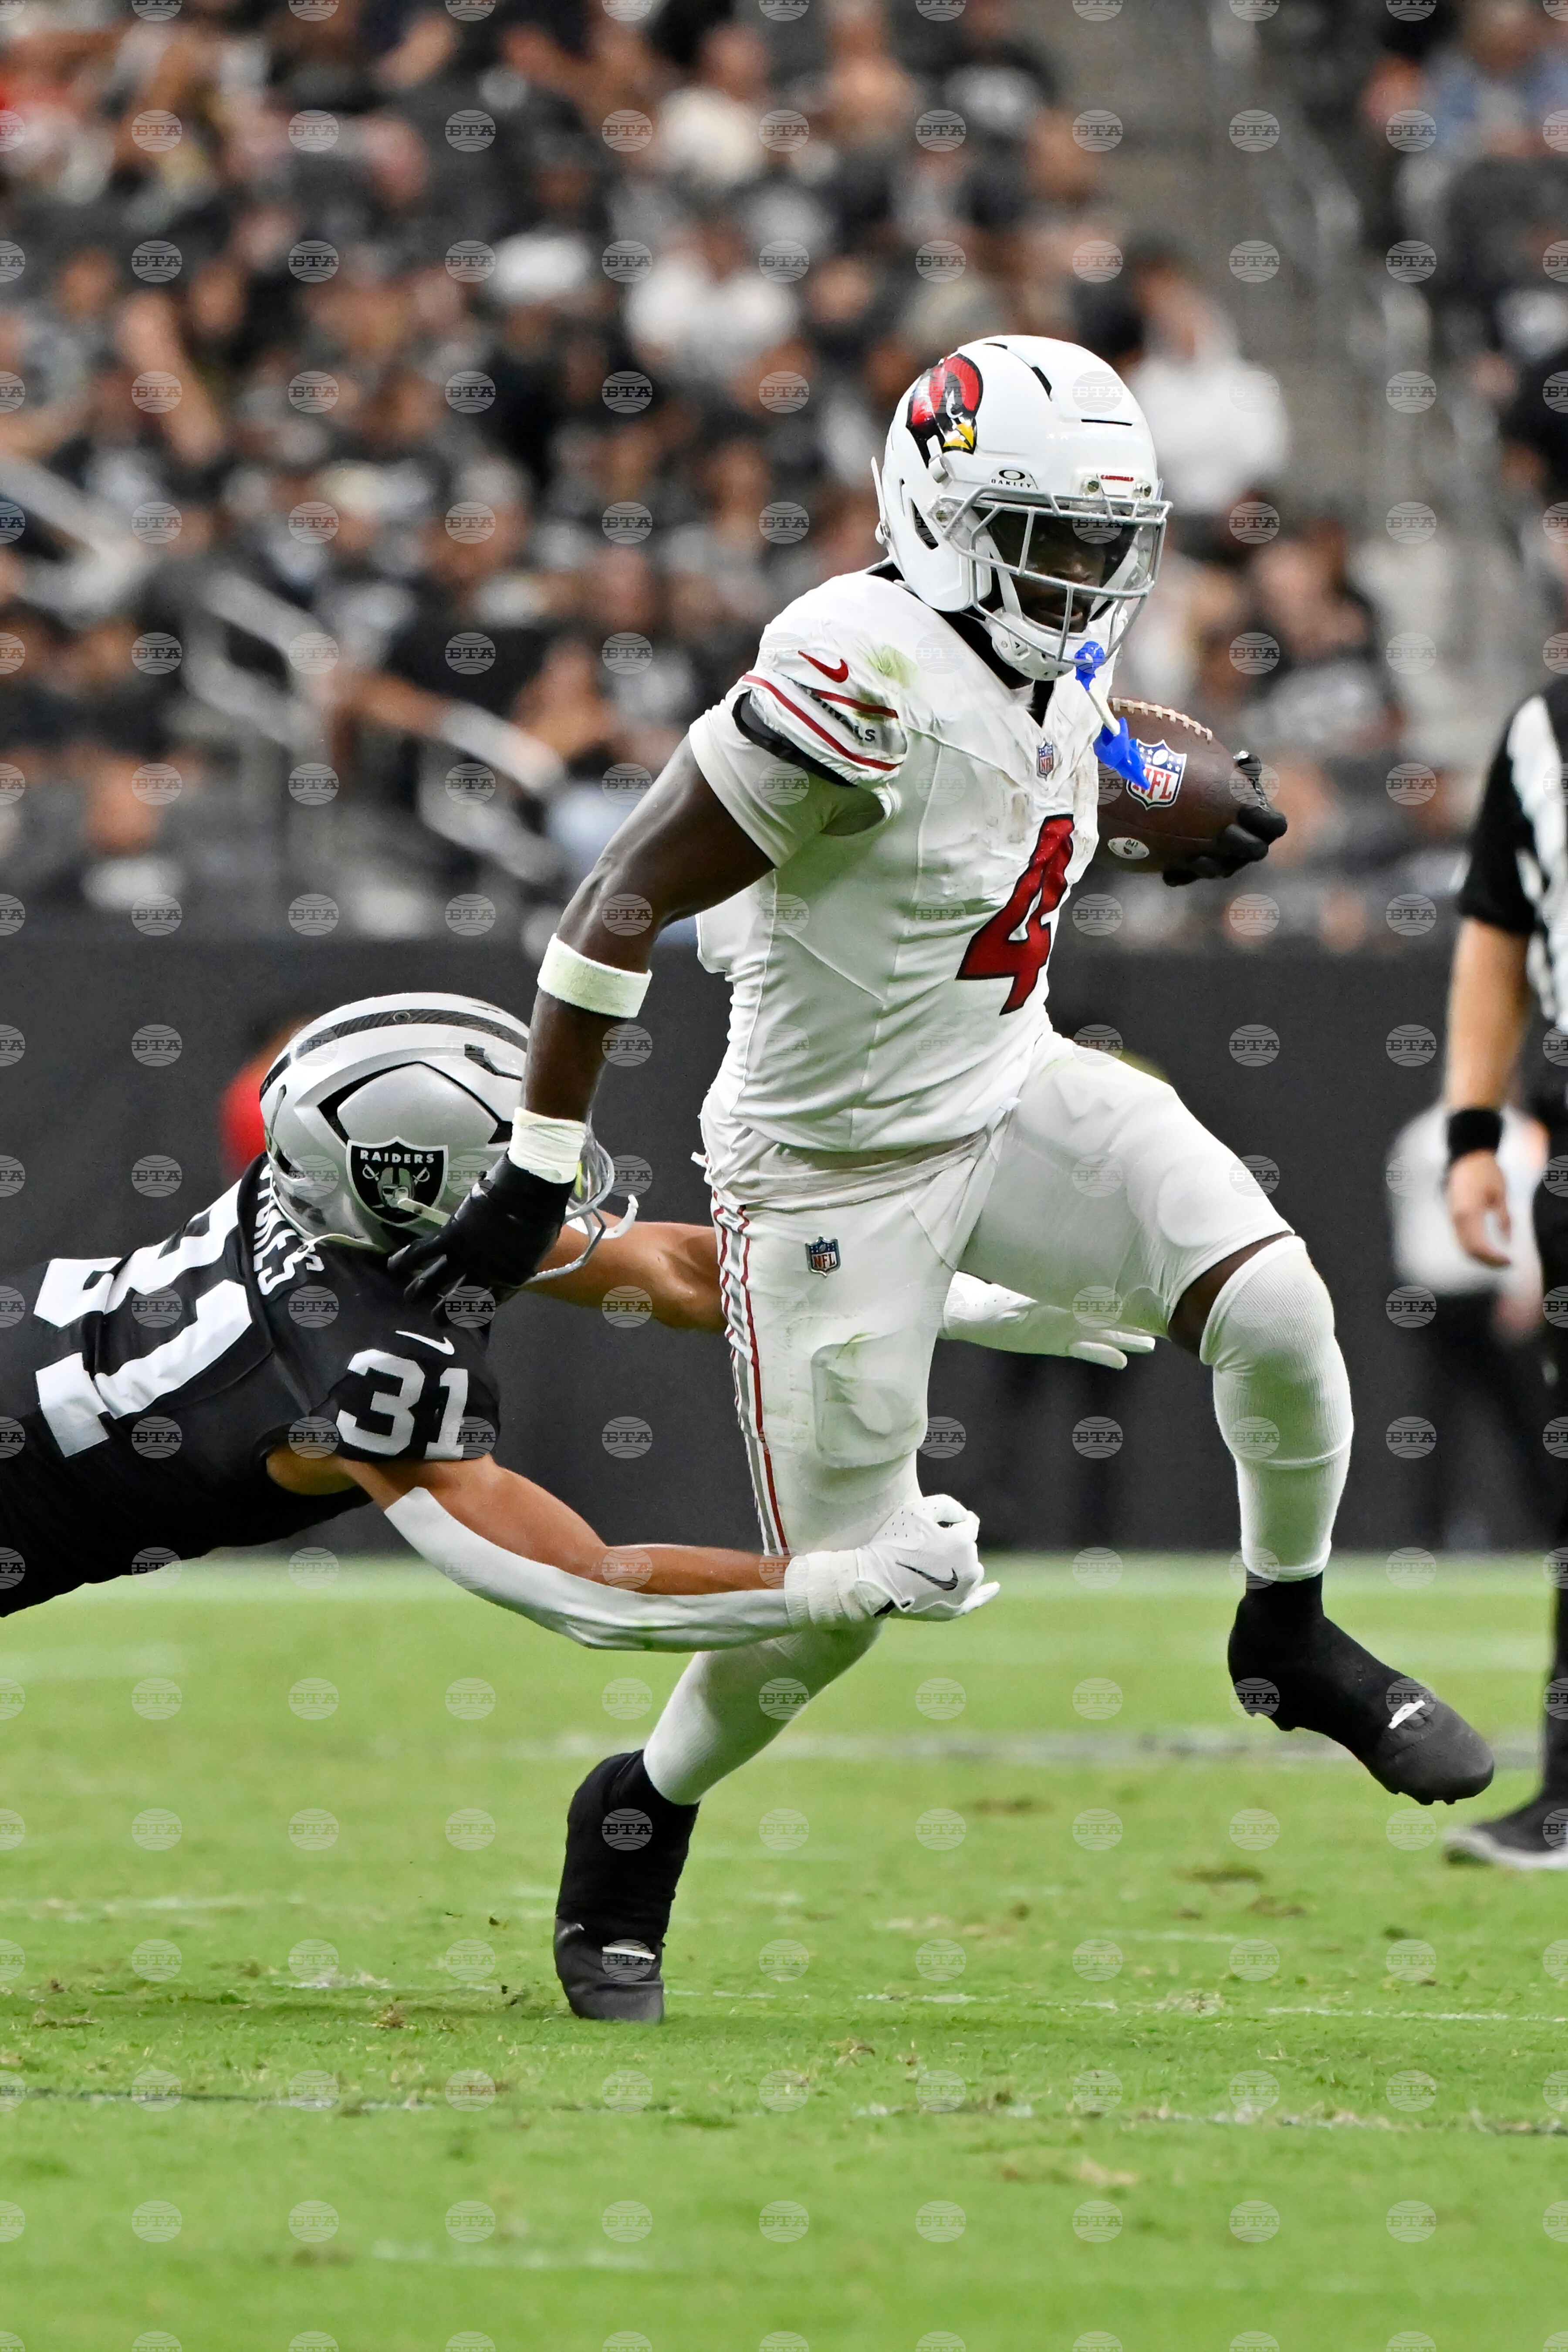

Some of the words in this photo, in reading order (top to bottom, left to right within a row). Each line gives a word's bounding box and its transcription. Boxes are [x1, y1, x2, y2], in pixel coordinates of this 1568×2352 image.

[991, 479, 1032, 488] OAKLEY
[955, 814, 1075, 1016] 4
[360, 1149, 434, 1164] RAIDERS
[812, 1253, 836, 1269] NFL
[336, 1349, 469, 1459] 31
